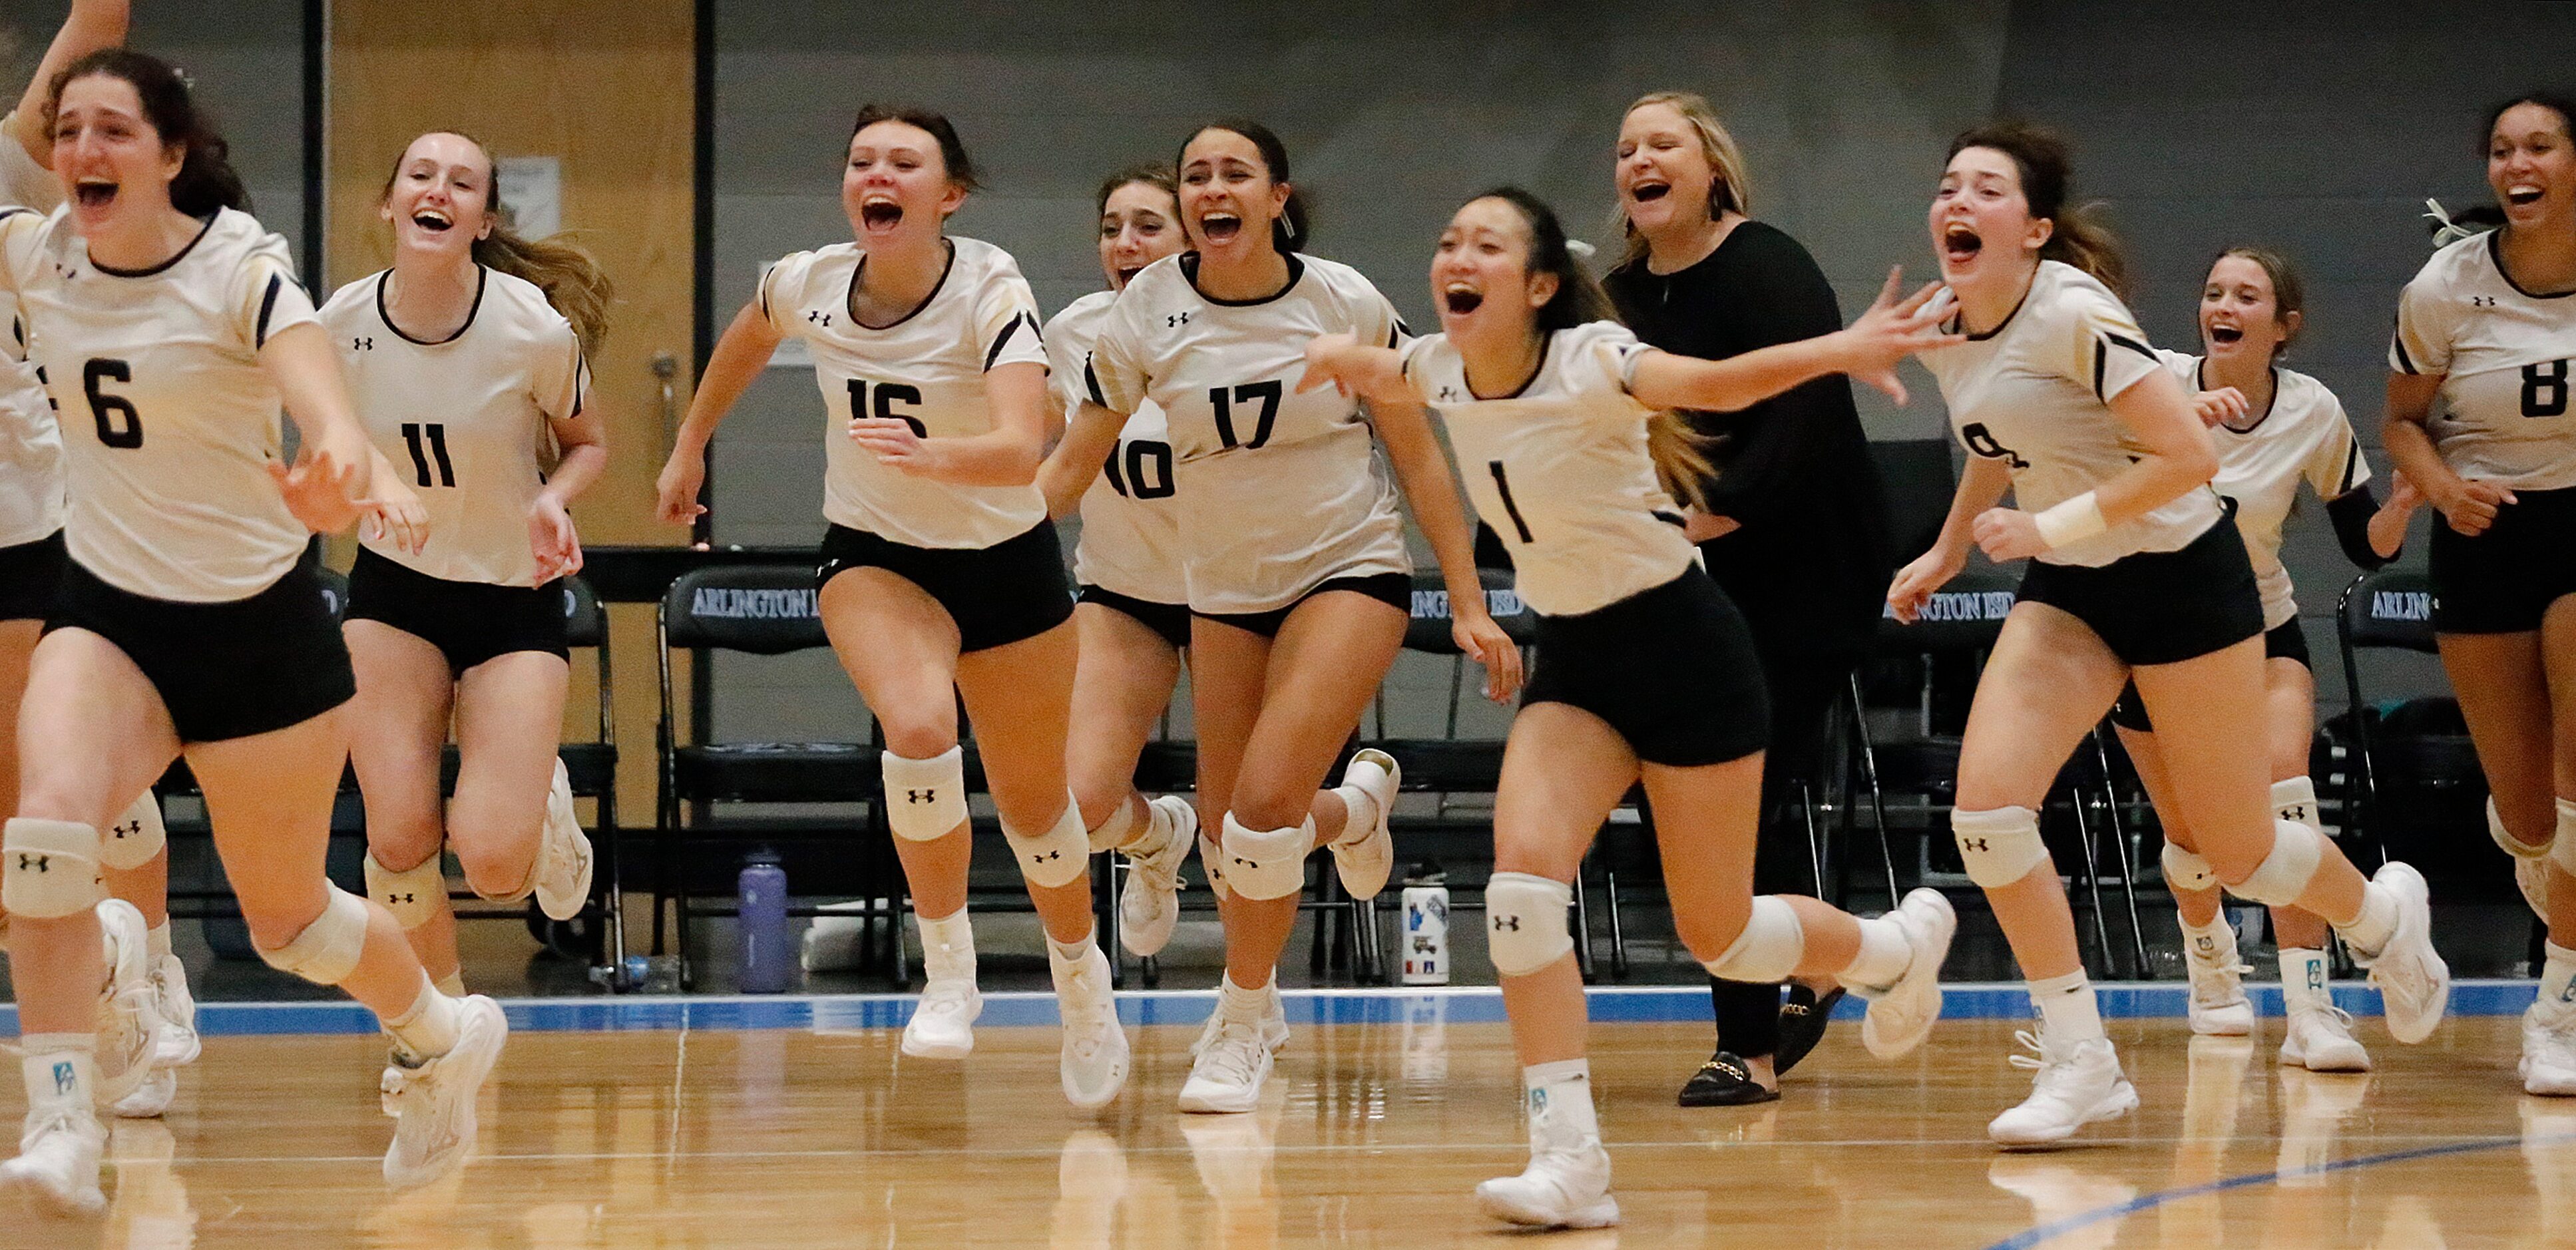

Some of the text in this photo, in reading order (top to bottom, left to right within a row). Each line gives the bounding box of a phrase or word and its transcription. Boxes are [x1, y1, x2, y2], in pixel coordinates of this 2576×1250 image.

[83, 357, 143, 449] 6
[1209, 379, 1282, 449] 17
[2521, 359, 2567, 417] 8
[401, 423, 455, 487] 11
[1489, 460, 1534, 543] 1
[691, 587, 809, 618] ARLINGTON
[2371, 590, 2431, 620] ARLIN
